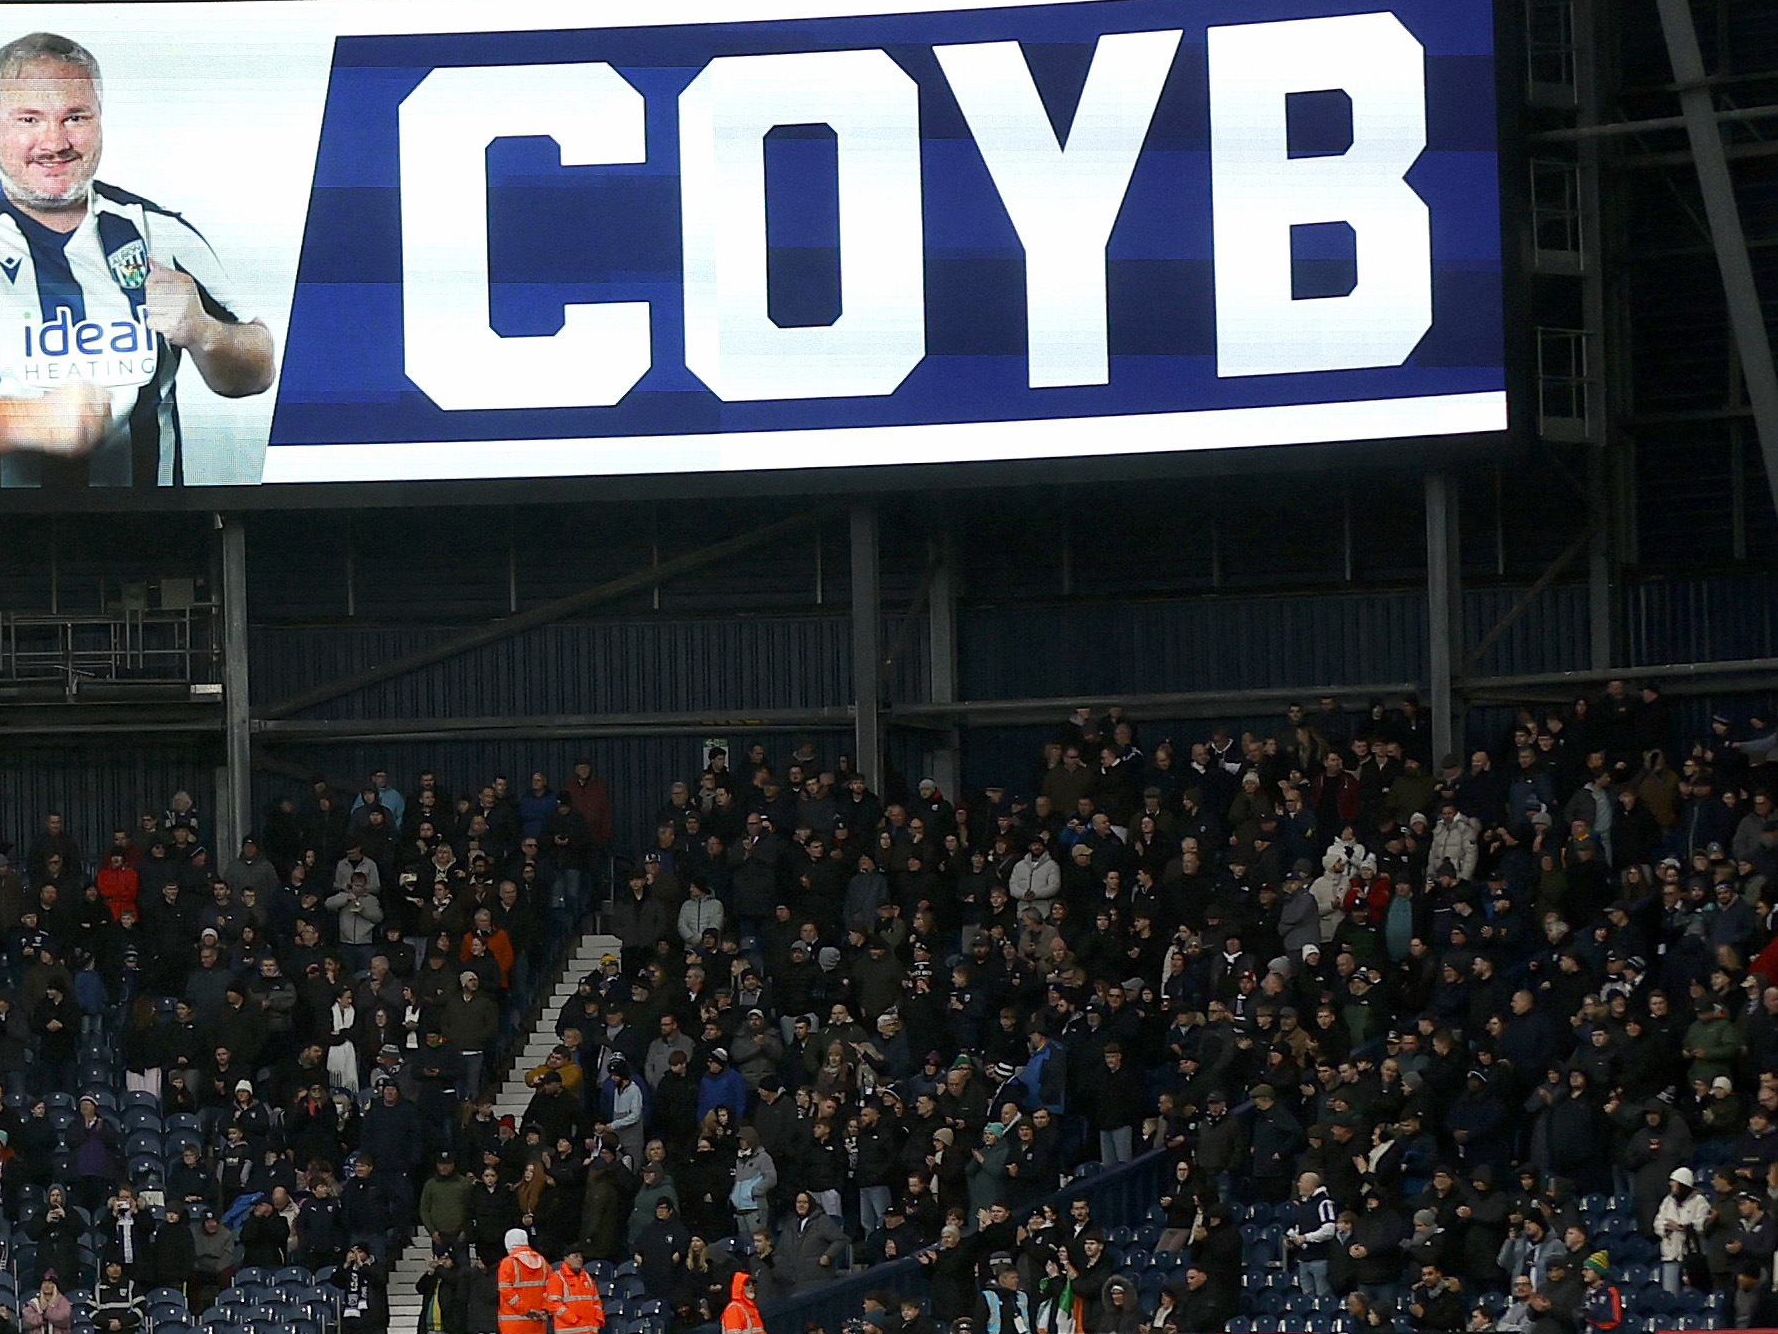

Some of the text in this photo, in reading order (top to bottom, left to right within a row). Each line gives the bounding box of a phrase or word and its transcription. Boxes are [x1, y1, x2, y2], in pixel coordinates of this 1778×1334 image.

[398, 11, 1433, 411] COYB
[23, 308, 154, 357] ideal
[25, 358, 155, 380] HEATING
